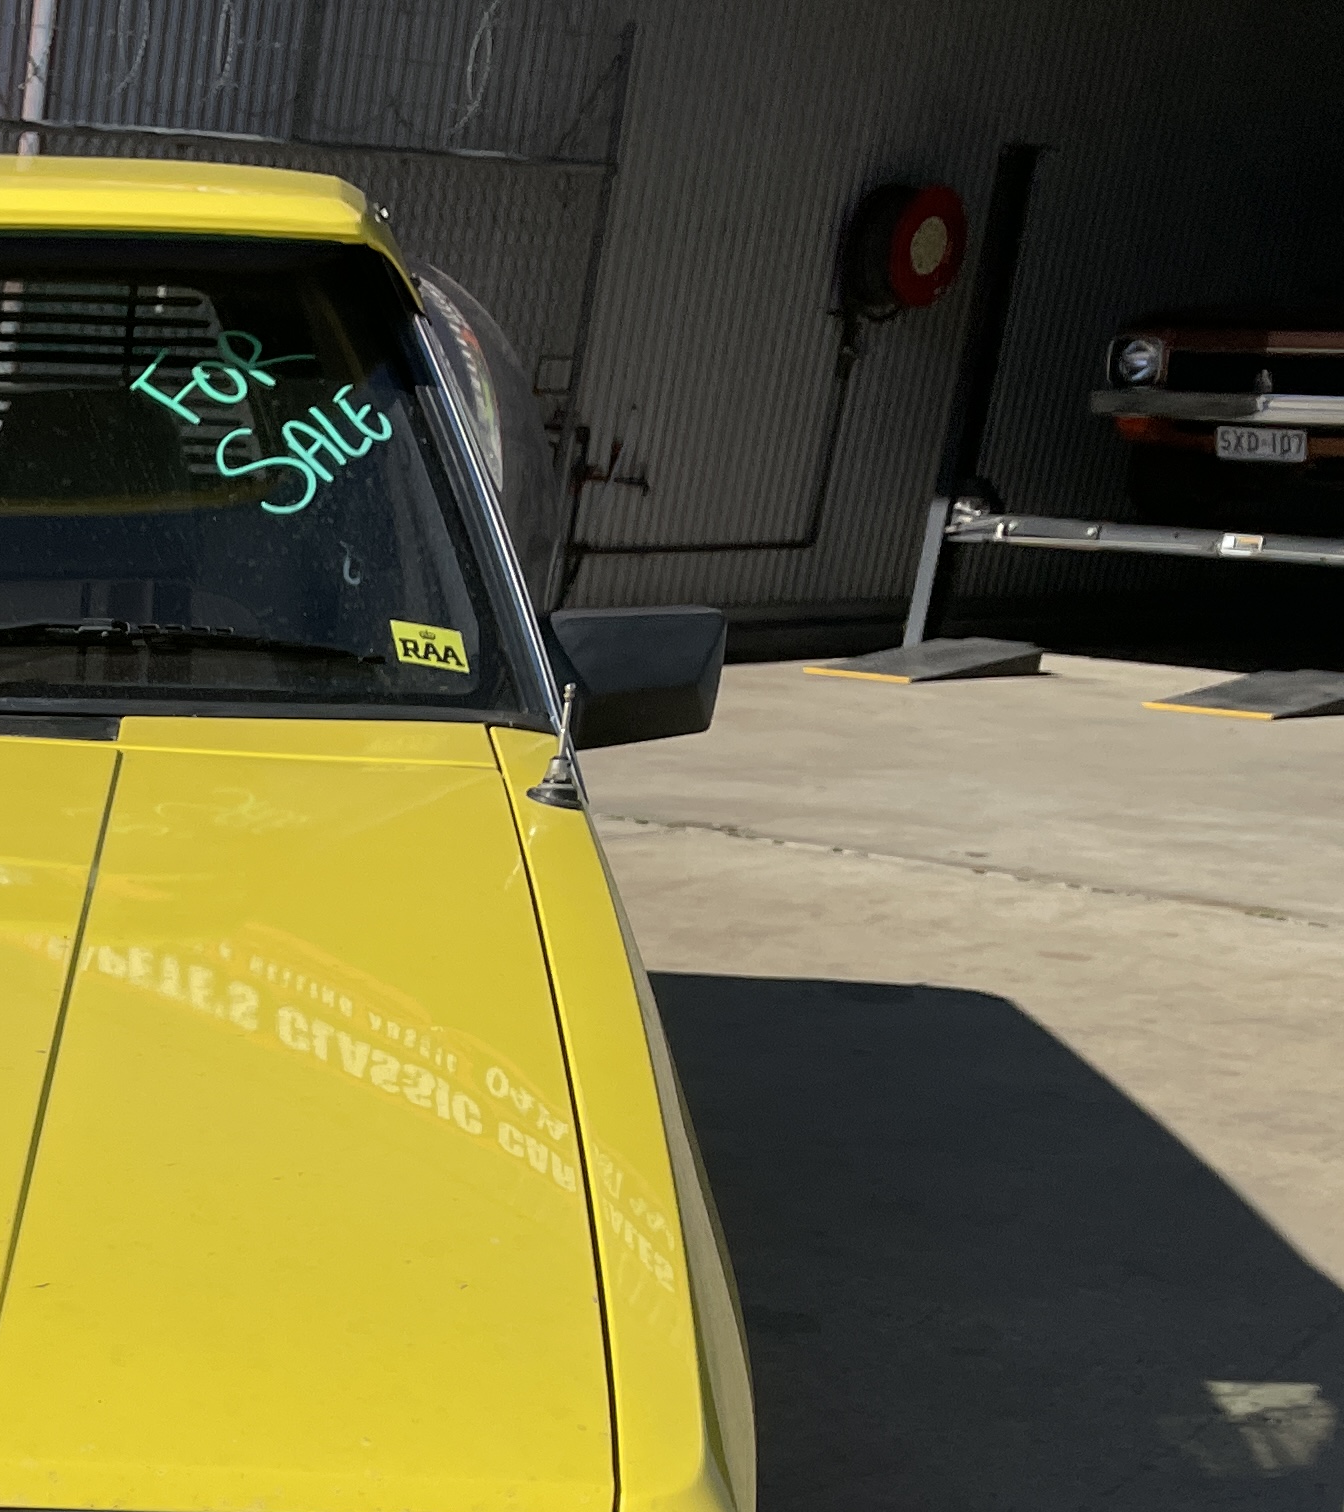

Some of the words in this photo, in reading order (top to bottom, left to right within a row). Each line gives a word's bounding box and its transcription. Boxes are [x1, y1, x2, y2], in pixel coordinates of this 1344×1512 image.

[129, 330, 315, 425] FOR
[216, 384, 393, 514] SALE
[399, 638, 466, 667] RAA
